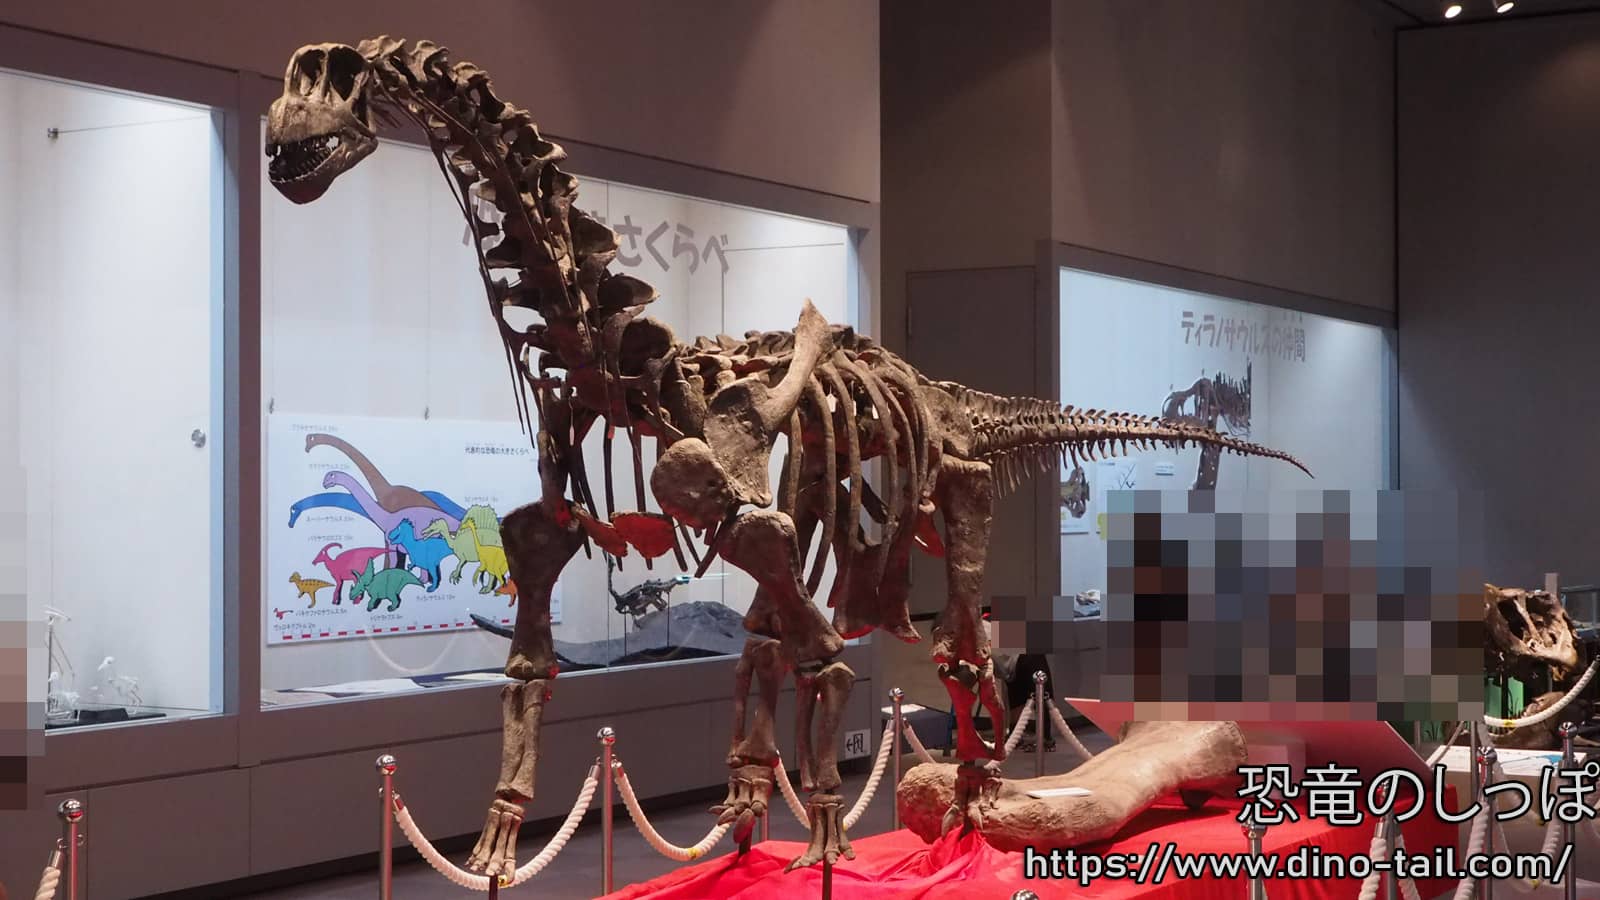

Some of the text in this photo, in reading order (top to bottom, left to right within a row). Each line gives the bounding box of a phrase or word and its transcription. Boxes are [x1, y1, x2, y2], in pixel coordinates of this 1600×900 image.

[1181, 311, 1306, 362] ティラノサウルスの仲間
